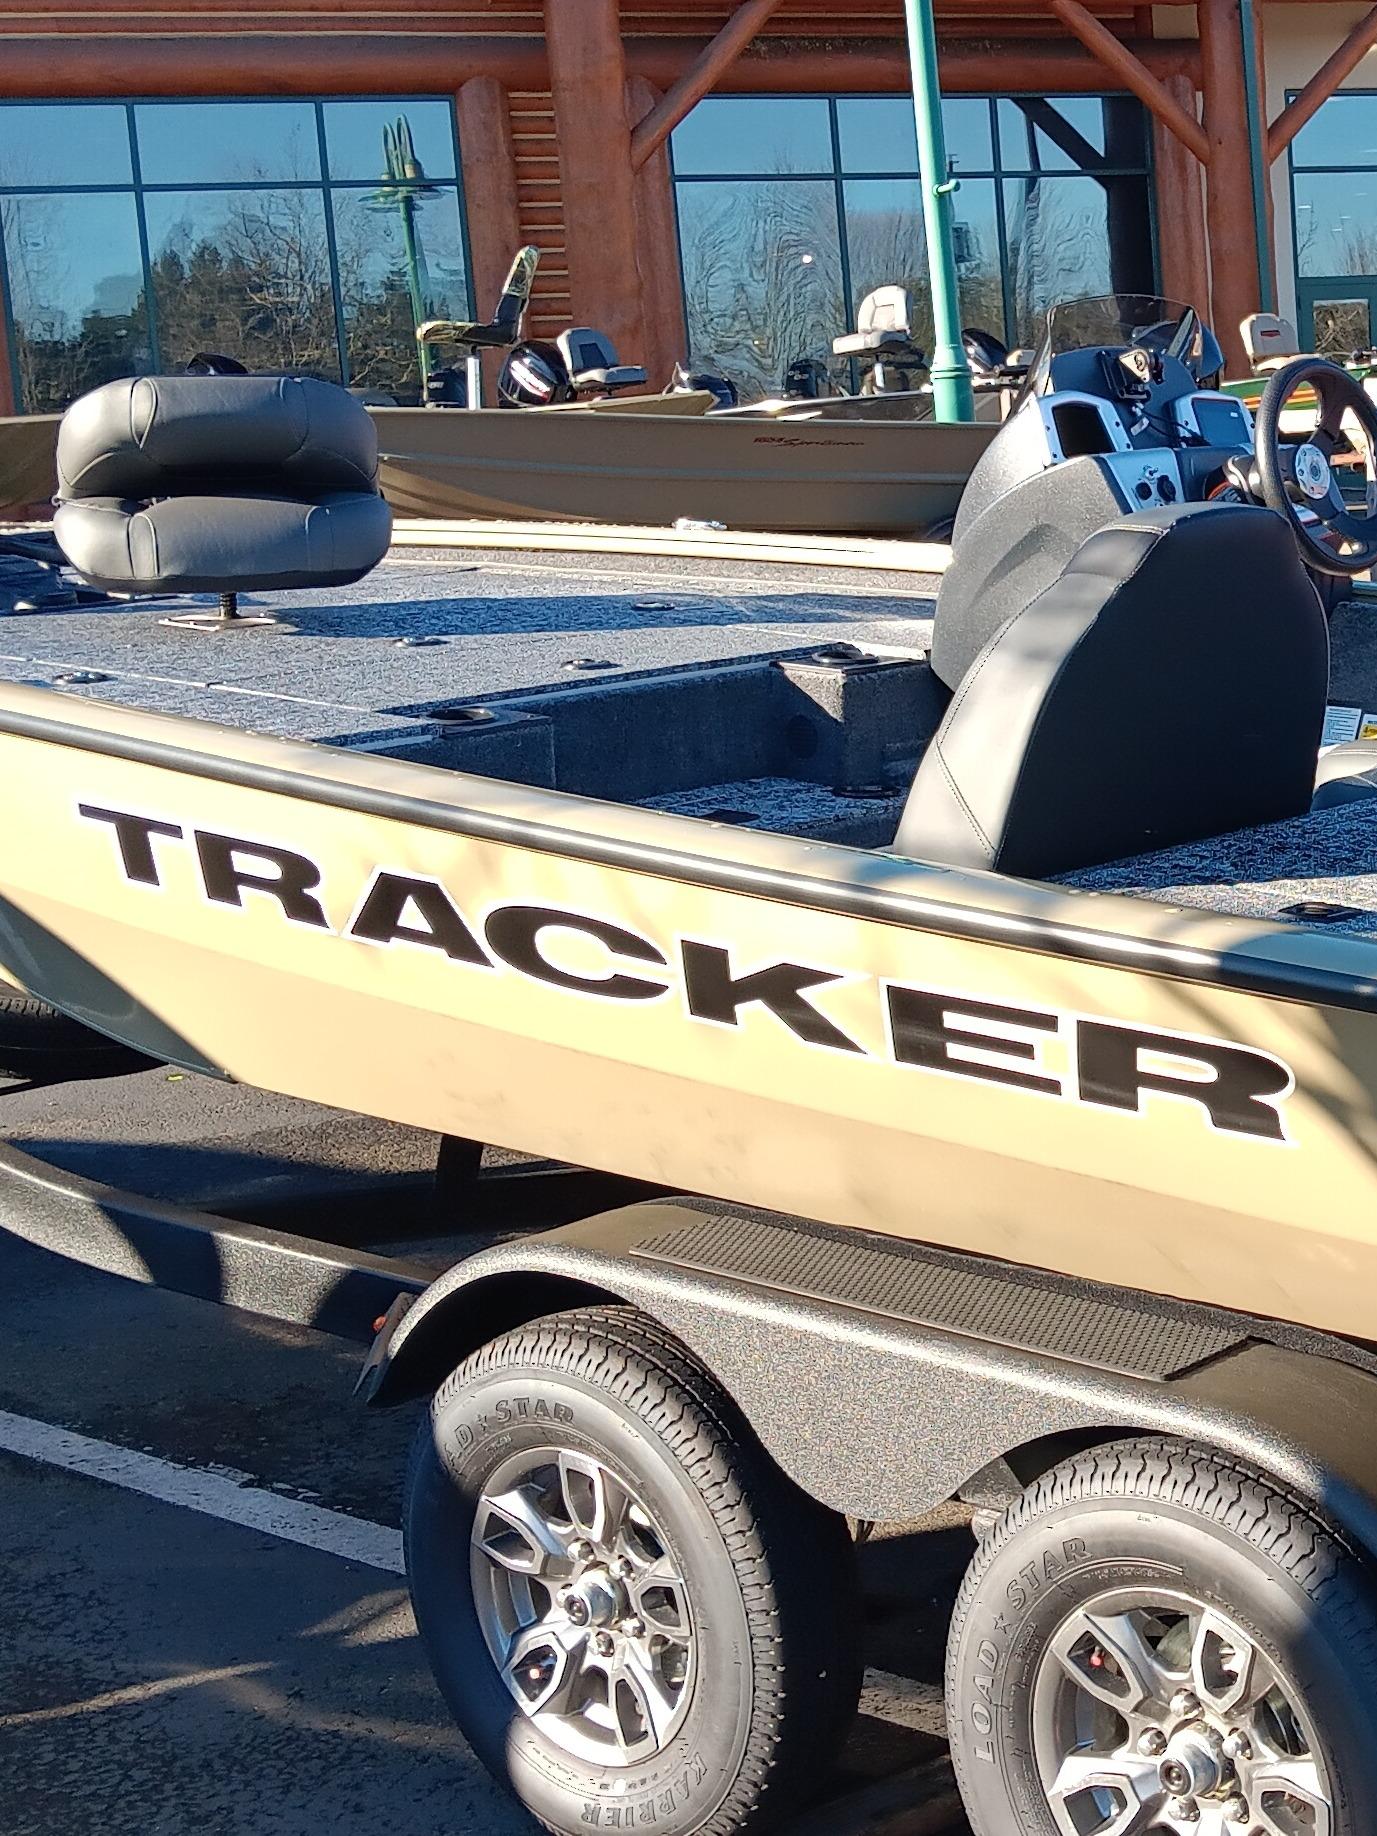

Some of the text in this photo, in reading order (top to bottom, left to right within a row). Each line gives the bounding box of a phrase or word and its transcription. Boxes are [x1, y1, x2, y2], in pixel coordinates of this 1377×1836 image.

[74, 799, 1297, 1144] TRACKER
[495, 1397, 575, 1427] STAR
[971, 1639, 1000, 1765] LOAD
[1006, 1536, 1093, 1610] STAR
